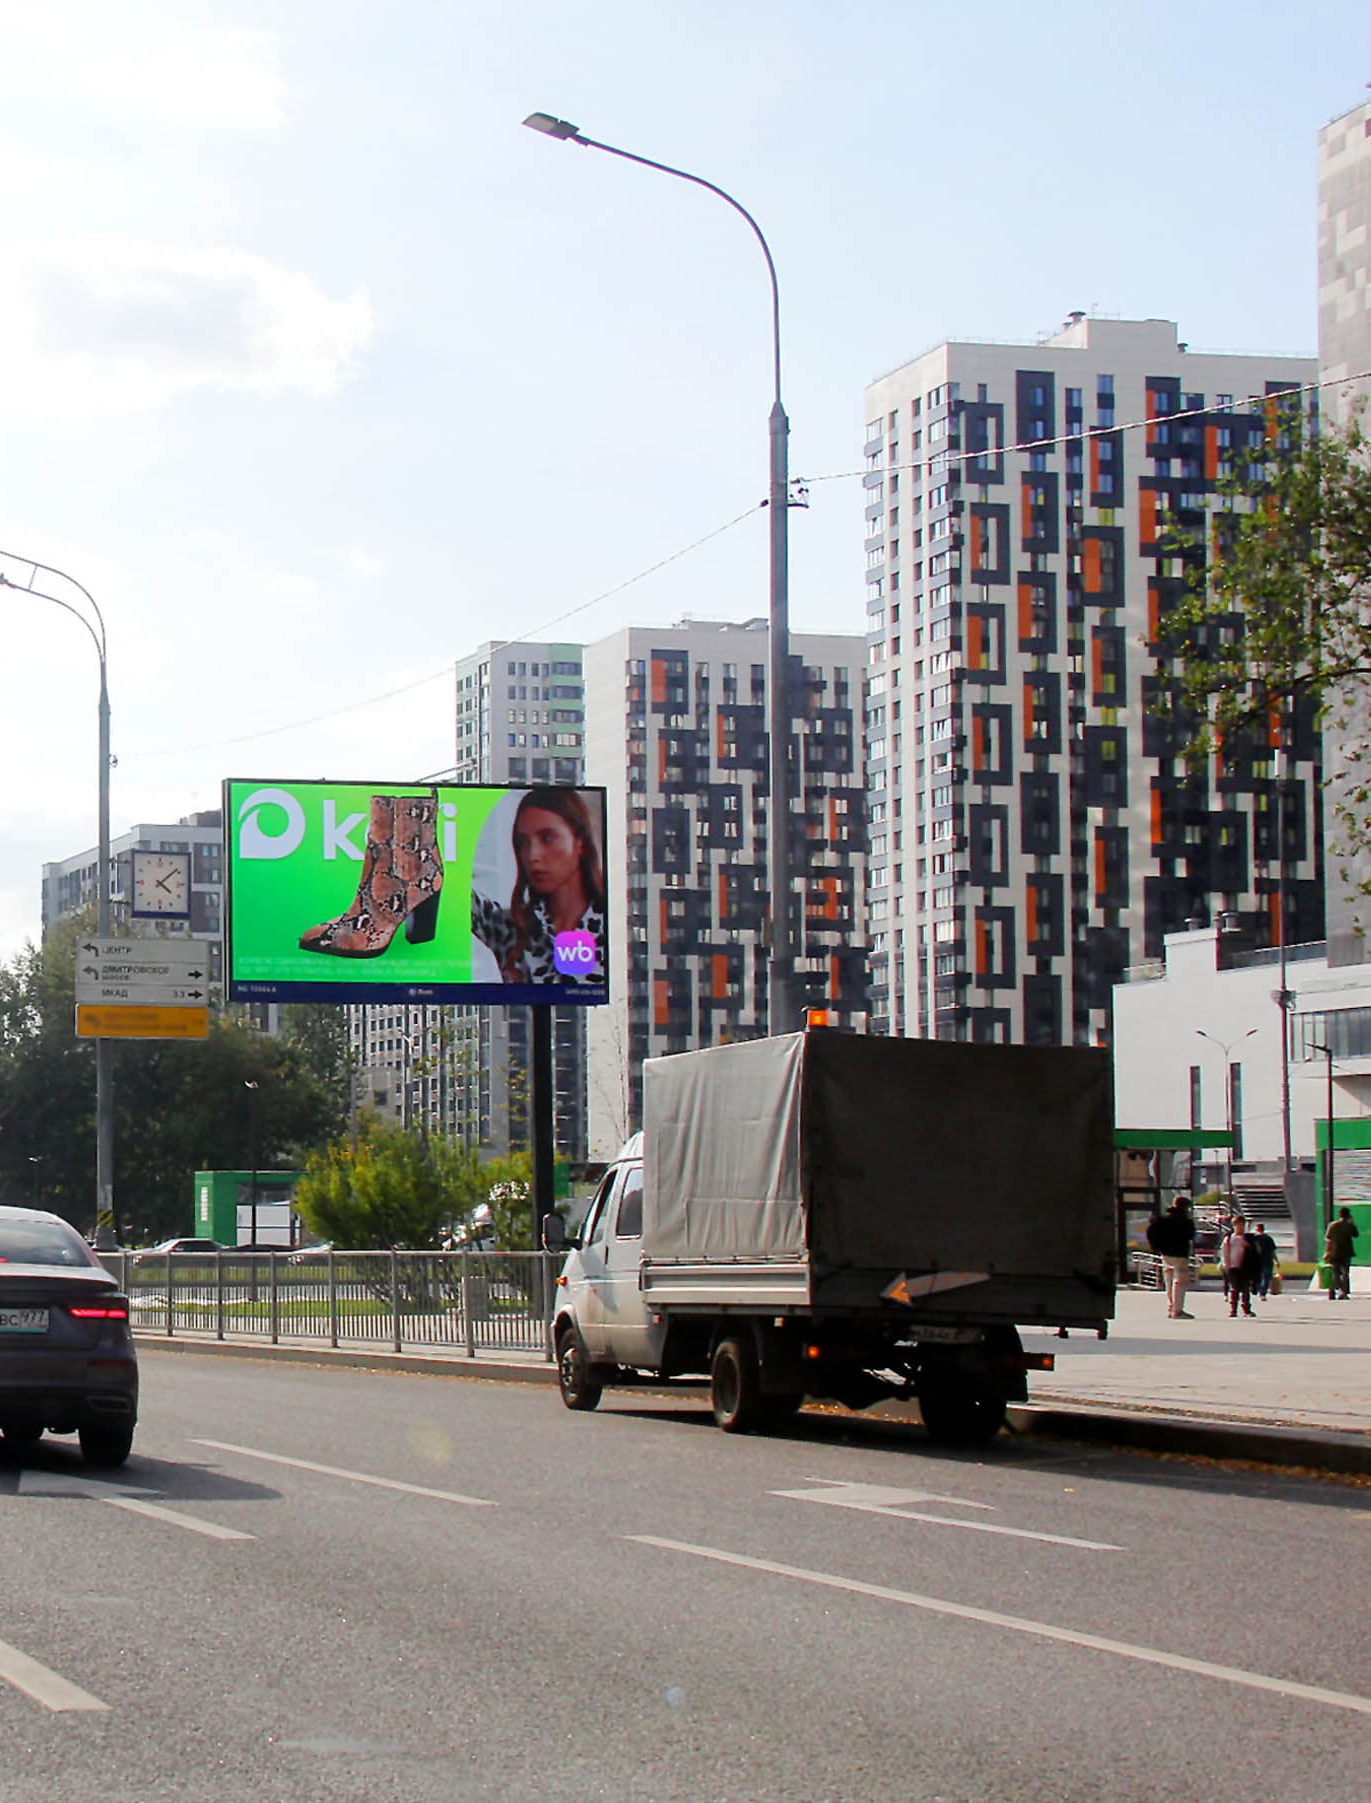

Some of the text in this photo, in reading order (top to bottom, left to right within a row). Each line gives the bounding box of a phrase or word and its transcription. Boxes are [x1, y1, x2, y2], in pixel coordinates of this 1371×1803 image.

[102, 945, 133, 955] ЦЕНТР
[556, 940, 593, 962] wb
[102, 965, 170, 975] ДМИТРОВСКОЕ
[102, 988, 129, 998] МКАД
